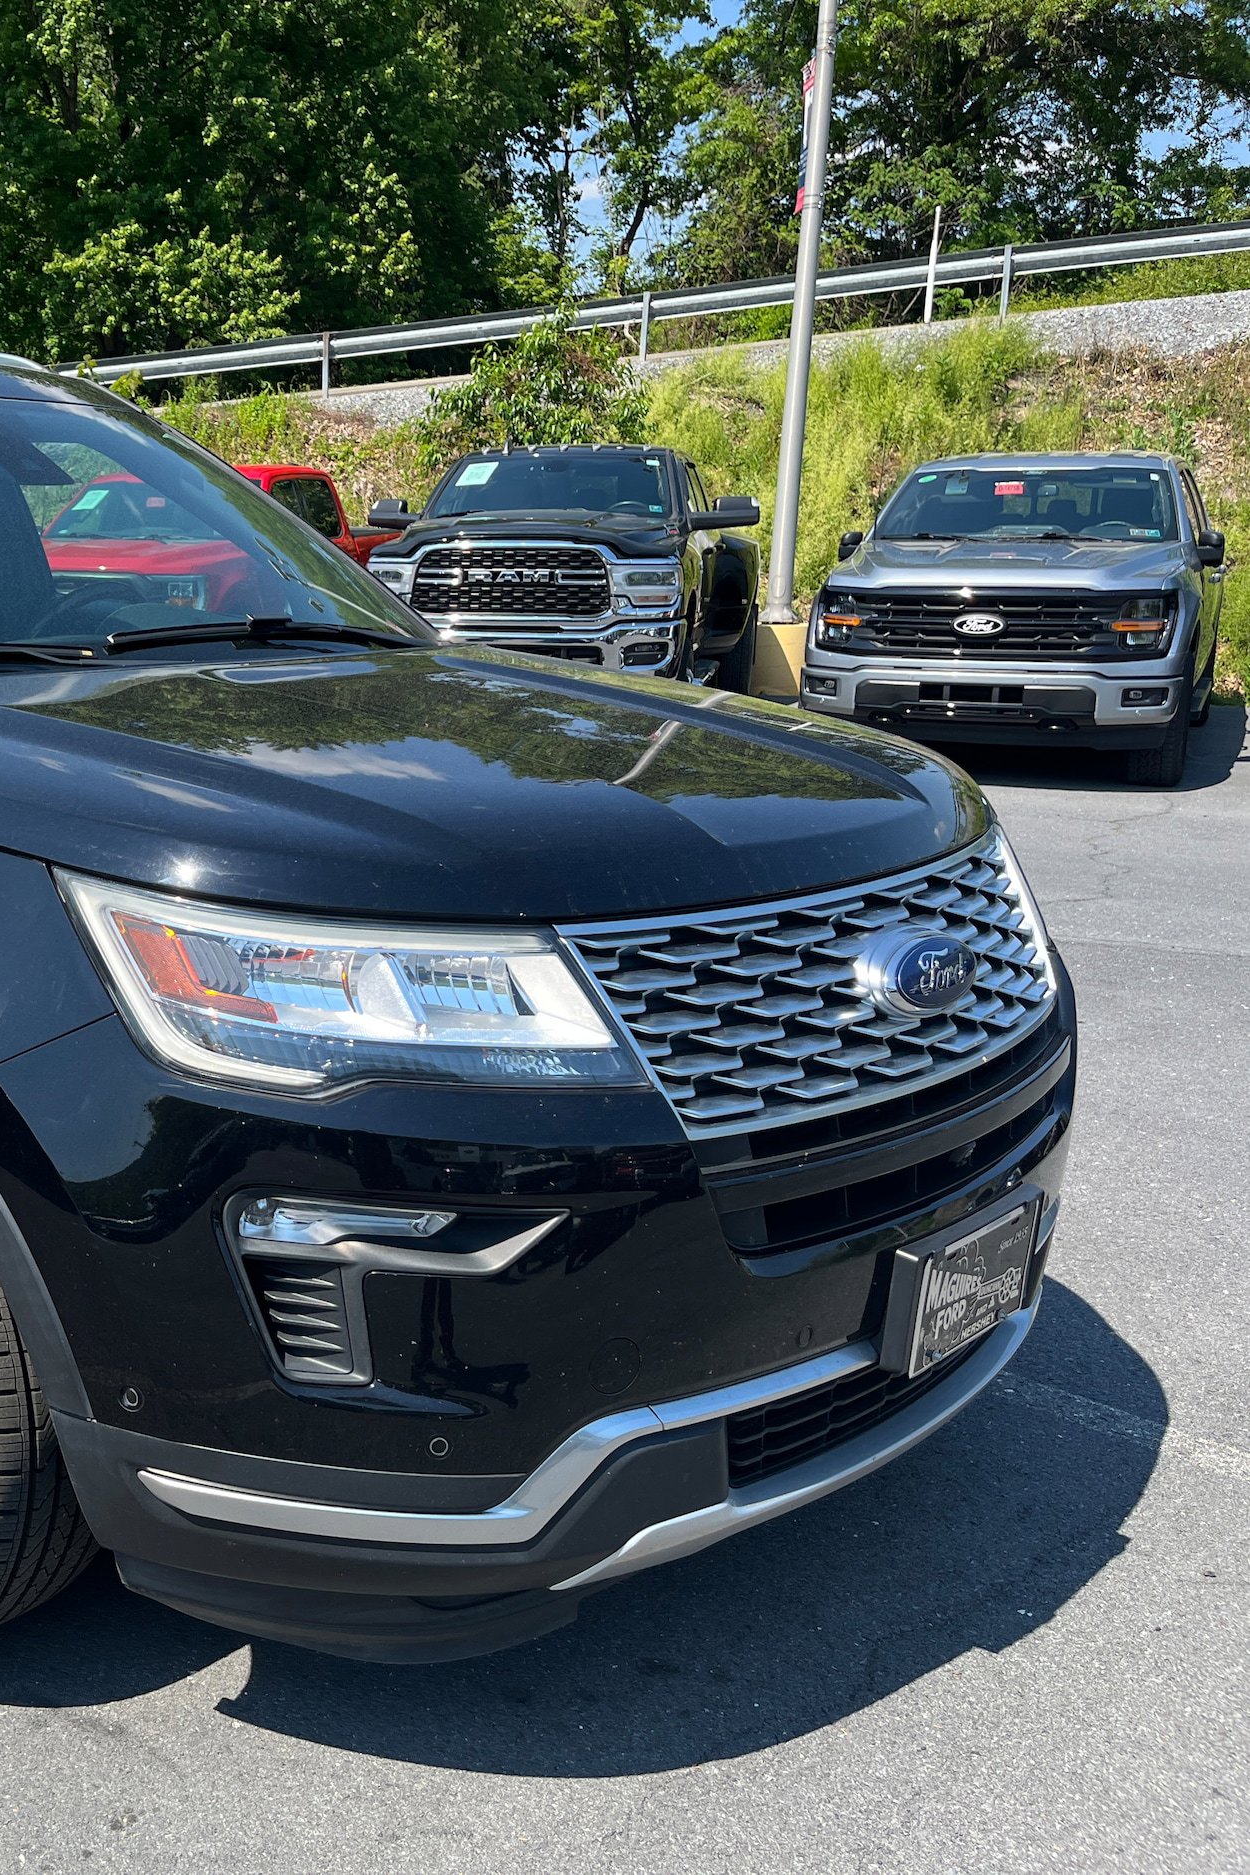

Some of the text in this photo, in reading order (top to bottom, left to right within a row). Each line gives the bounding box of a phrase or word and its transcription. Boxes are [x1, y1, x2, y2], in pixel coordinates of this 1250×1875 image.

[467, 568, 550, 583] RAM
[962, 619, 995, 632] Ford
[910, 947, 968, 997] Ford
[934, 1298, 967, 1340] FORD
[960, 1310, 997, 1341] HERSHEY
